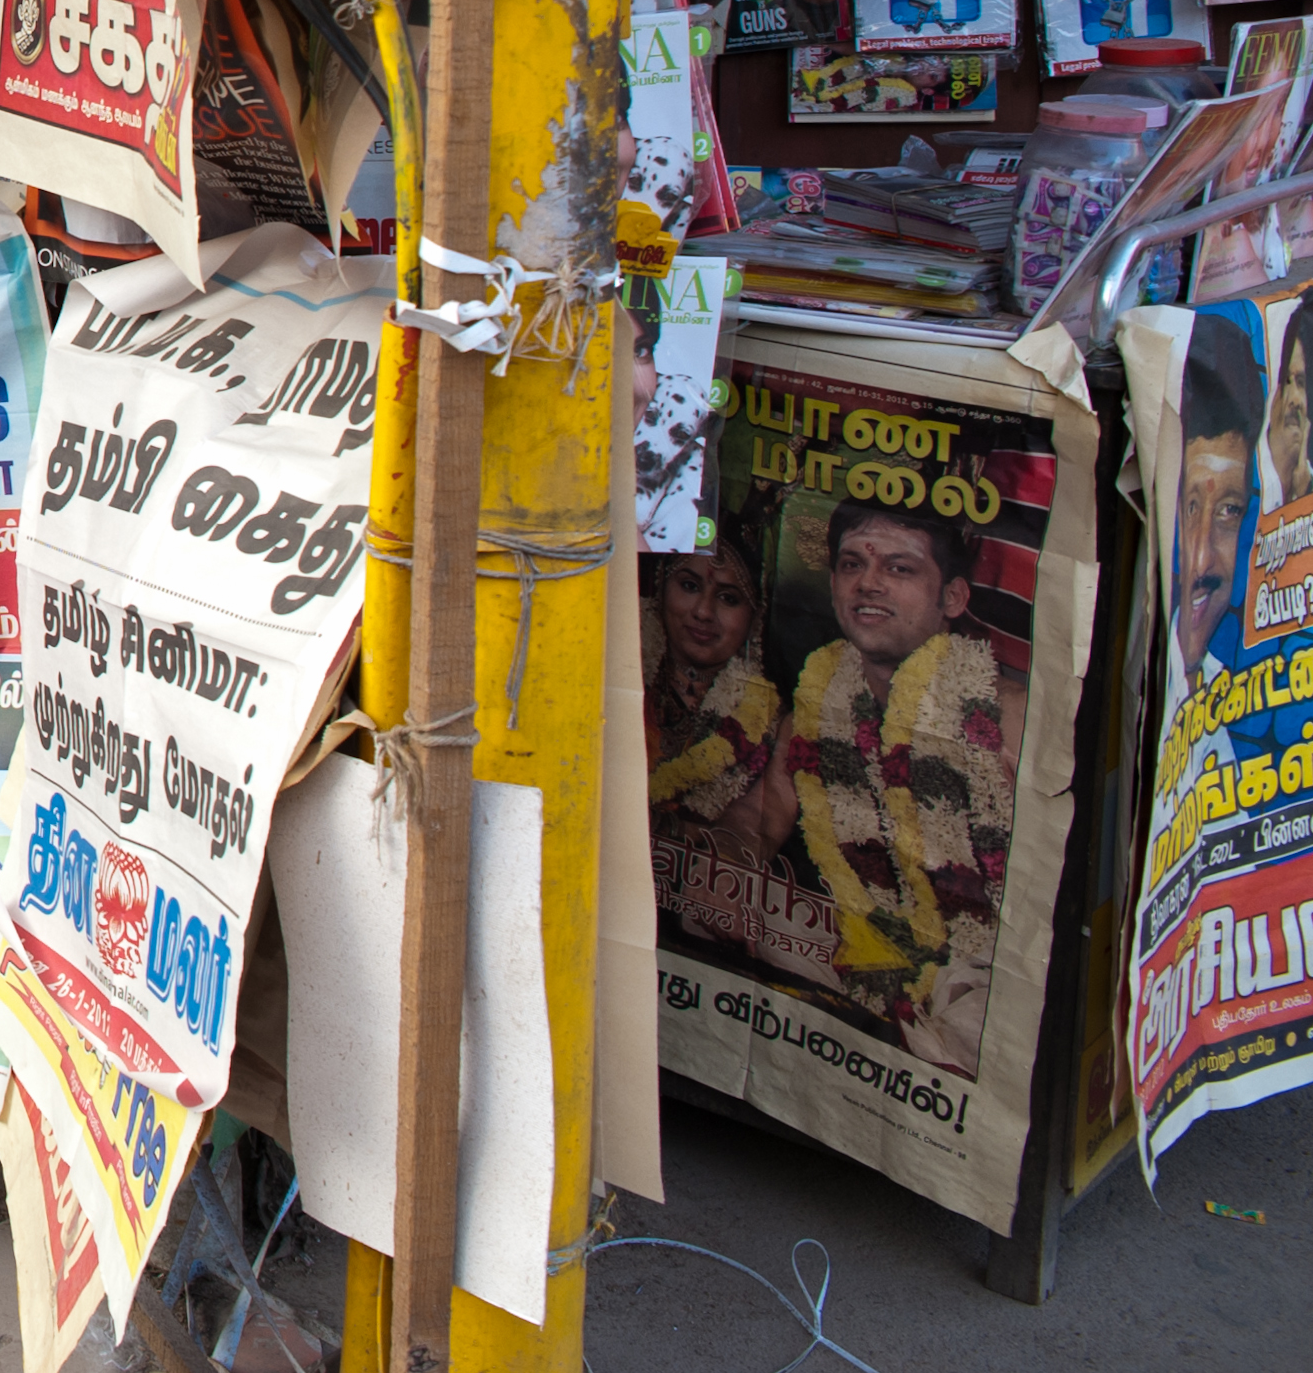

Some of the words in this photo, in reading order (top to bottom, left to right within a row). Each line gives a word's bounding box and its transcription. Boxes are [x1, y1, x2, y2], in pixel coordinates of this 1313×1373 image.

[739, 6, 788, 35] GUNS
[982, 34, 1005, 47] traps
[40, 401, 179, 516] தம்பி
[171, 463, 371, 617] கைது
[751, 435, 1002, 526] மாலை
[42, 577, 113, 678] தமிழ்
[162, 735, 257, 860] மோதல்
[145, 885, 234, 1058] மலர்
[743, 903, 836, 967] bhava
[713, 988, 971, 1136] விற்பனையில்!
